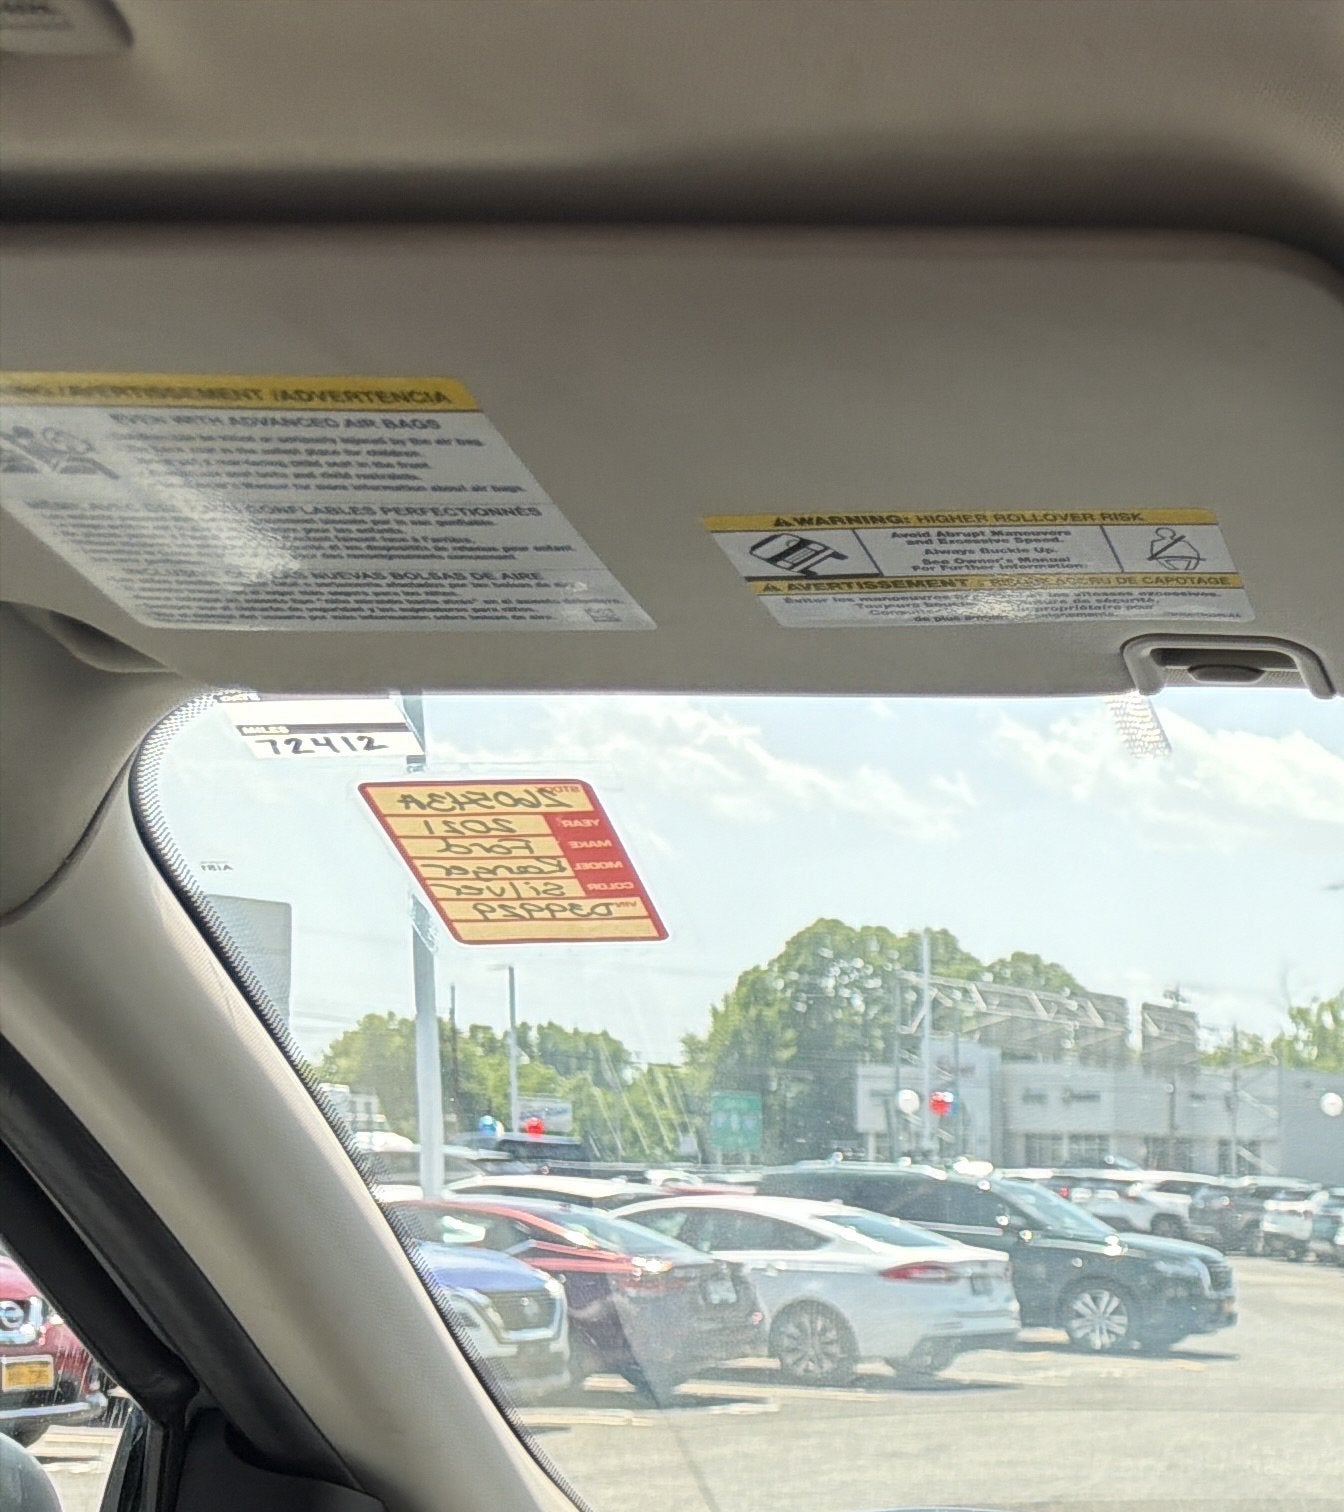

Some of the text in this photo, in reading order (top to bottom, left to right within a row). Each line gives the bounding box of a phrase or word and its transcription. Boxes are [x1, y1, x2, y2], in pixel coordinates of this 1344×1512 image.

[228, 415, 340, 428] ADVANCED
[342, 417, 377, 429] AIR
[382, 418, 442, 430] BAGS
[380, 504, 543, 518] PERFECTIONNÉS
[793, 511, 1145, 527] WARNING: HIGHER ROLLOVER RISK
[891, 531, 931, 539] Avoid
[905, 537, 933, 545] and
[313, 571, 386, 582] NUEVAS
[391, 571, 467, 582] BOLSAS
[471, 572, 495, 582] DE
[499, 571, 544, 582] AIRE
[787, 578, 969, 592] AVERTISSEMENT
[1115, 576, 1137, 585] DE
[1141, 575, 1230, 586] CAPOTAGE
[255, 736, 388, 755] 72412
